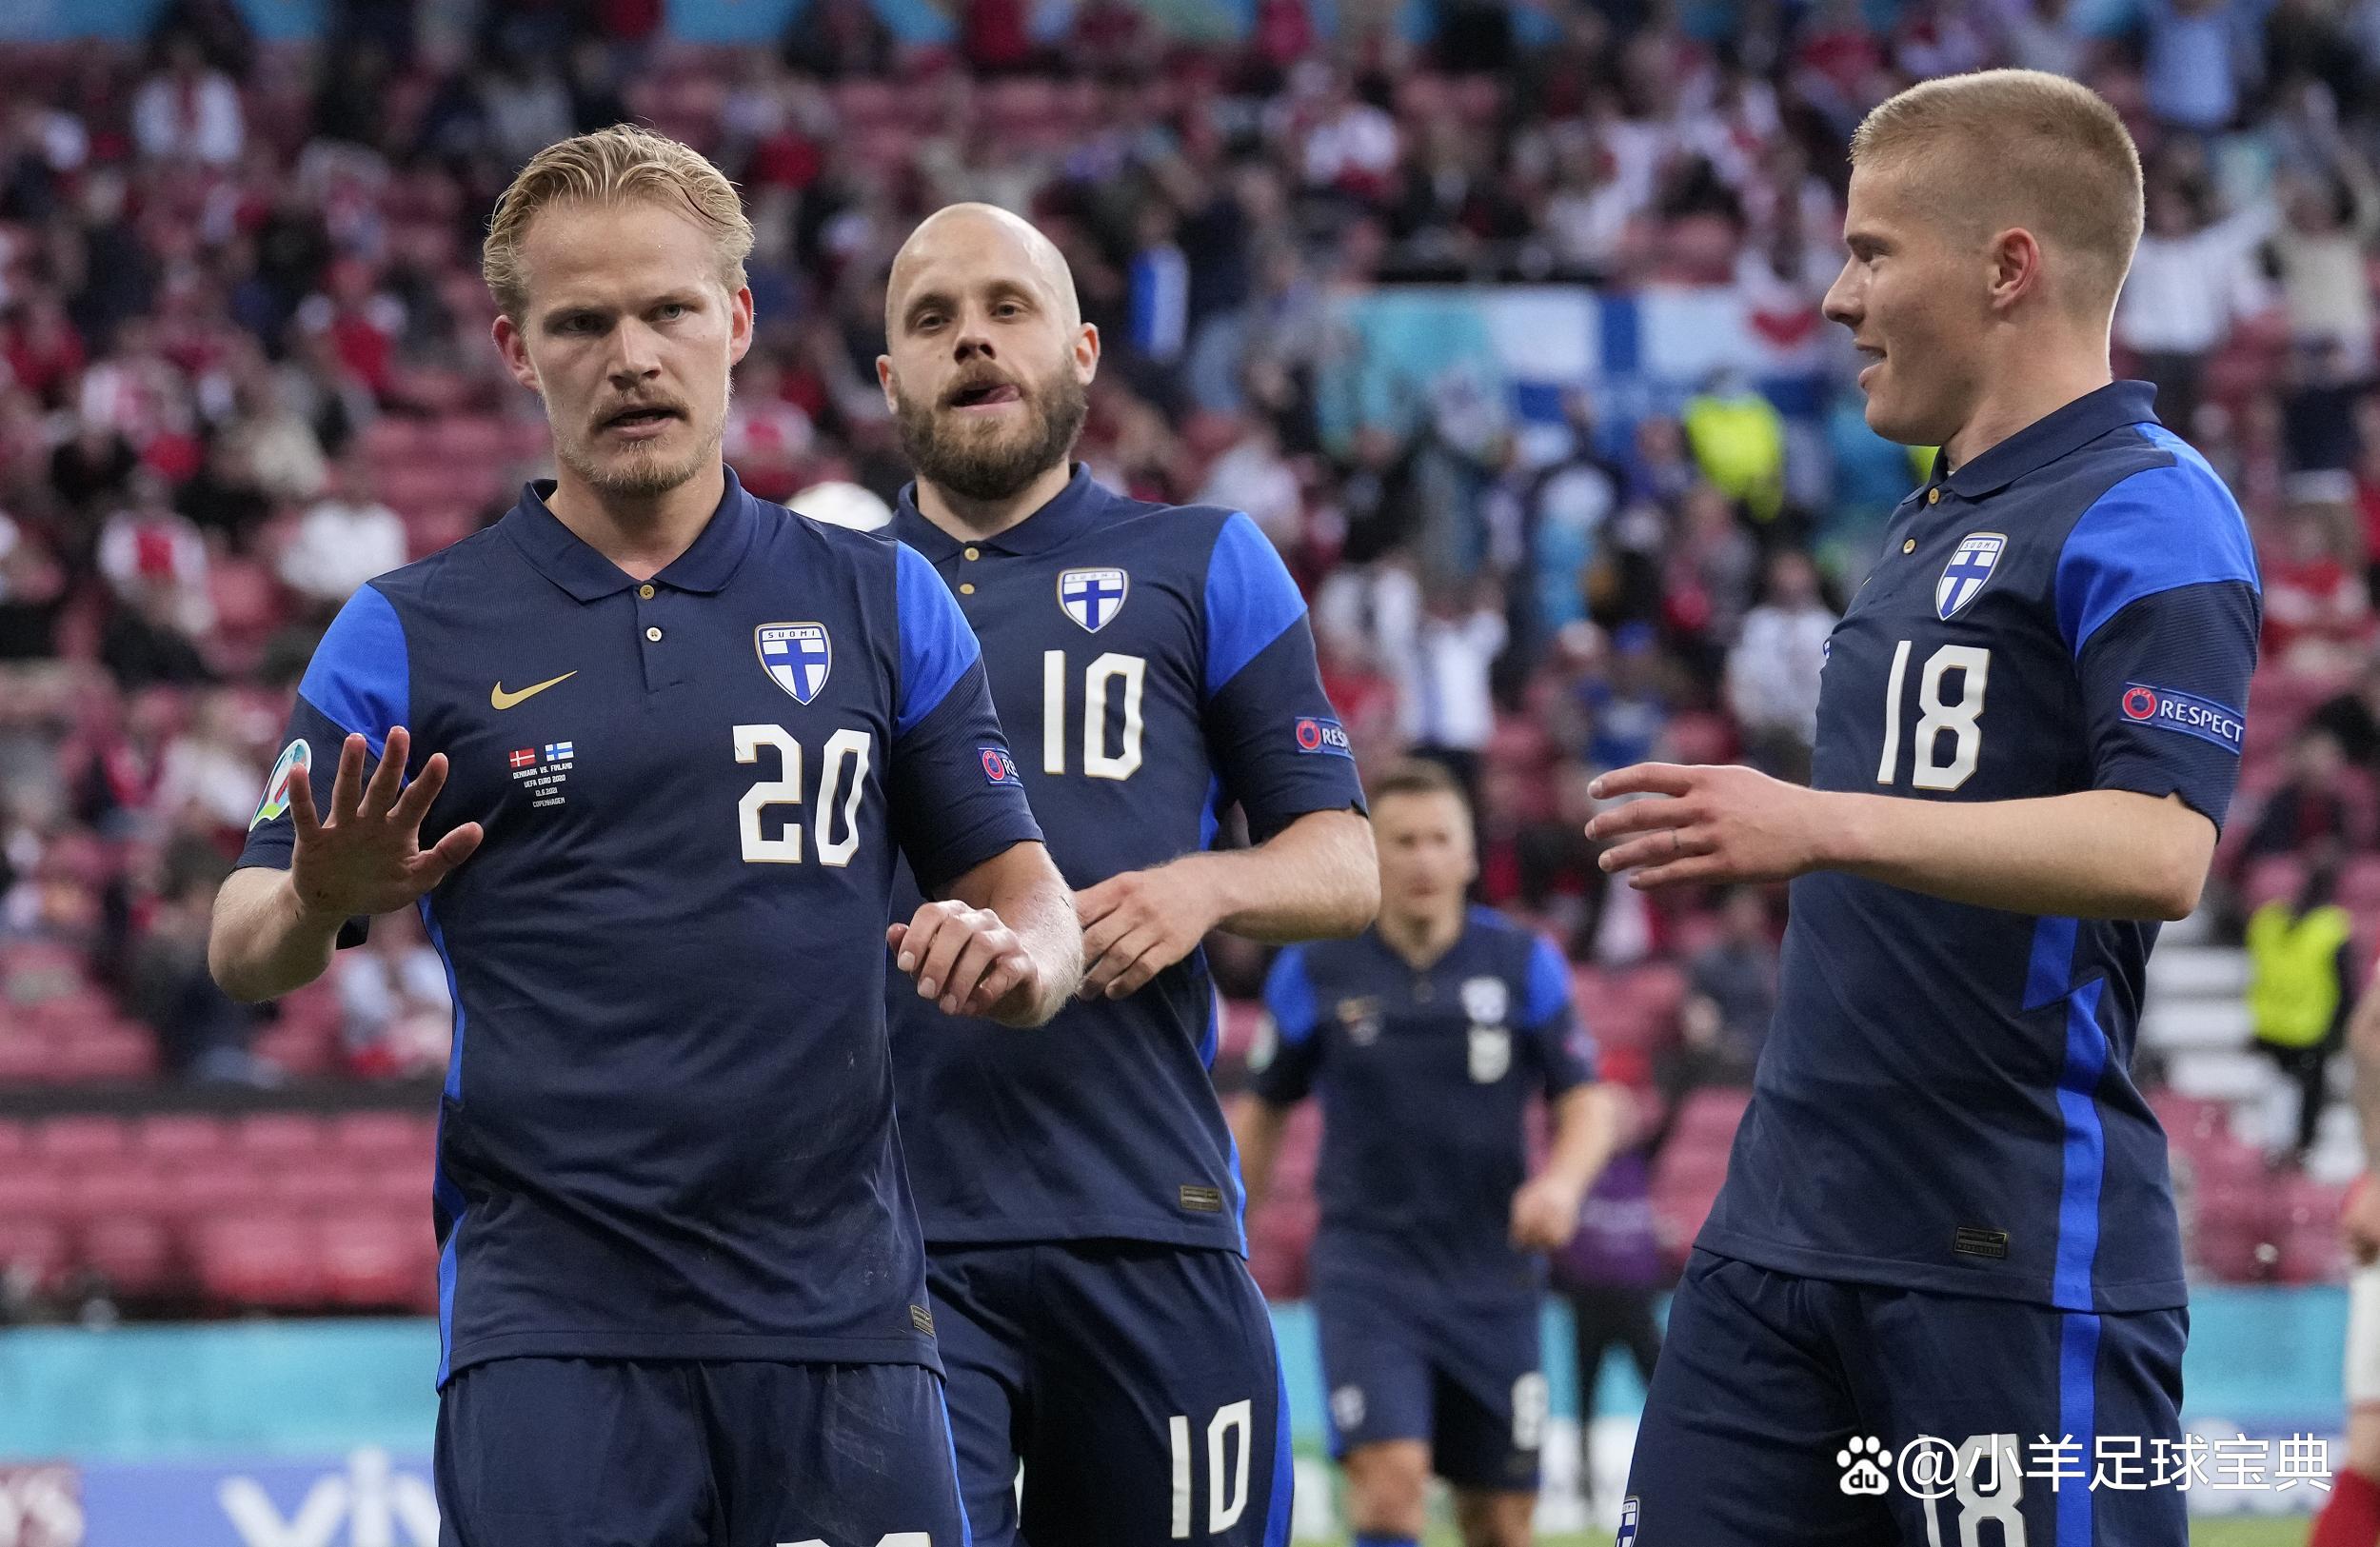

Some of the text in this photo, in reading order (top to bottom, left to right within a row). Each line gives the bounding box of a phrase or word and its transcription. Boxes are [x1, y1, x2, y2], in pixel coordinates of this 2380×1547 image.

[767, 630, 815, 639] SUOMI
[1043, 649, 1146, 782] 10
[1876, 640, 1991, 791] 18
[2159, 699, 2244, 743] RESPECT
[513, 768, 537, 779] DENMARK
[551, 763, 572, 772] FINLAND
[533, 797, 565, 807] COPENHAGEN
[538, 776, 551, 785] EURO
[552, 774, 565, 783] 2020
[733, 724, 871, 868] 20
[1169, 1398, 1251, 1539] 10
[1917, 1433, 2028, 1547] 18
